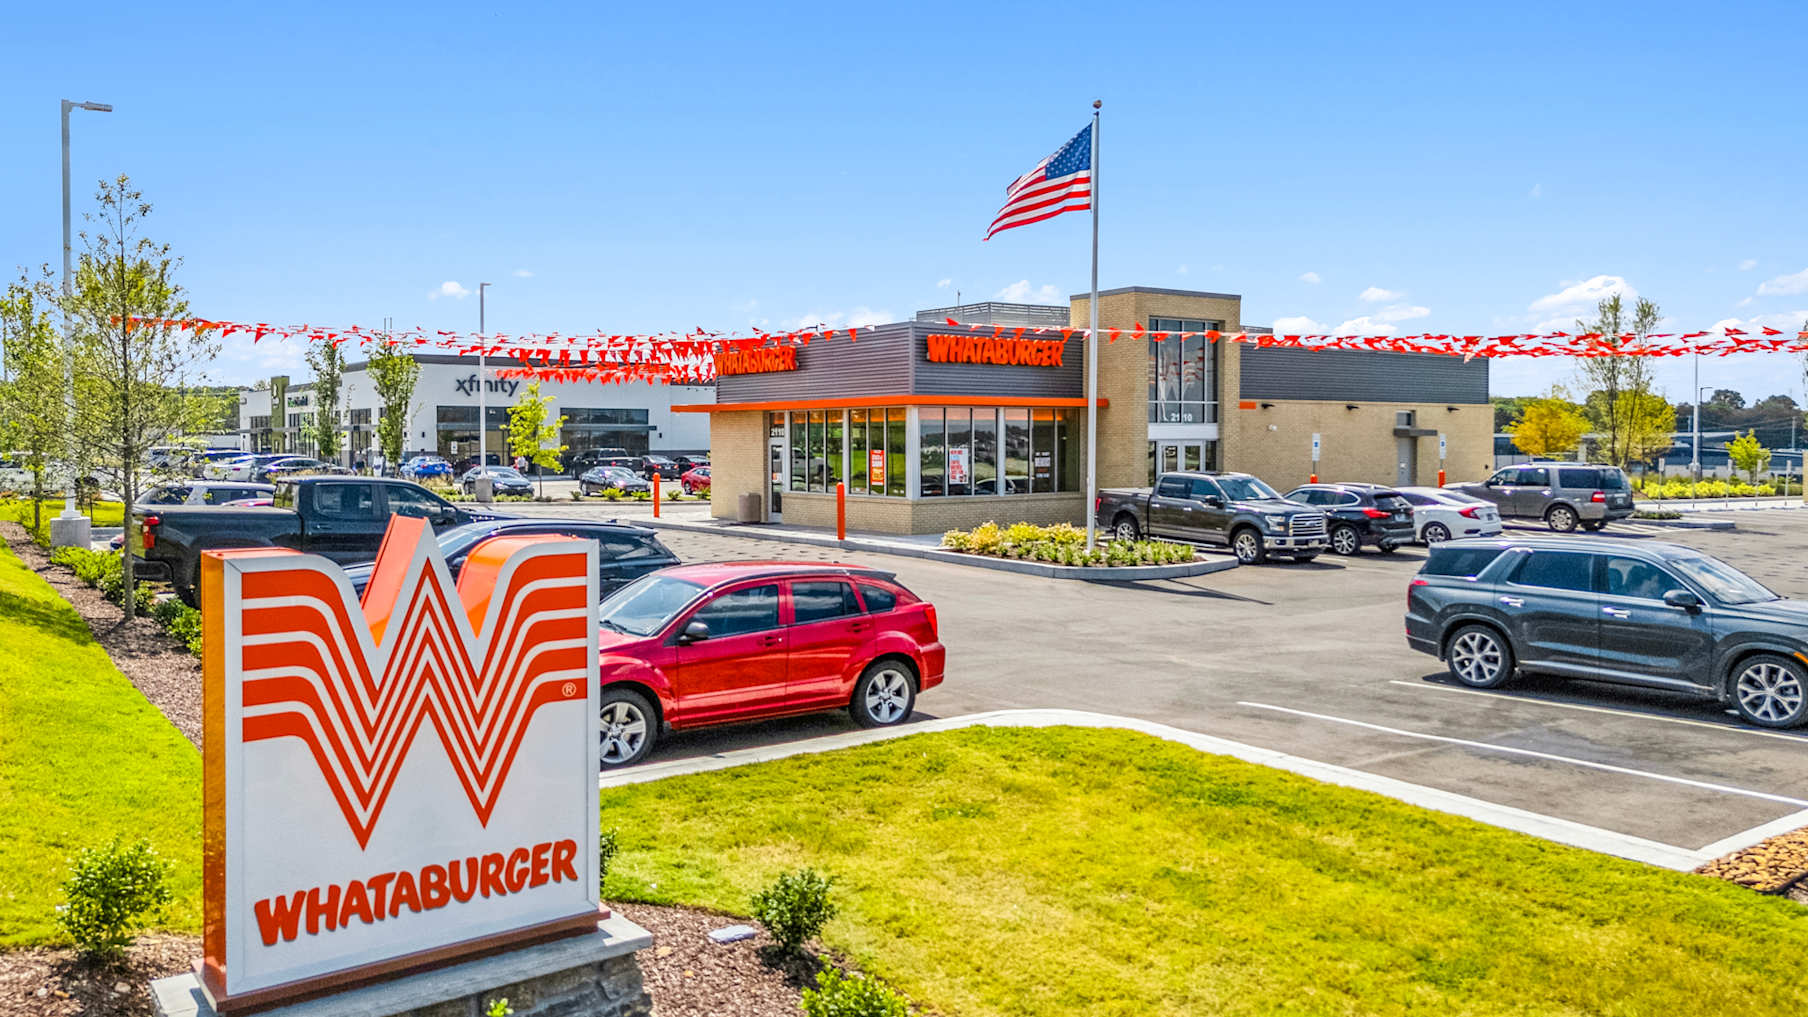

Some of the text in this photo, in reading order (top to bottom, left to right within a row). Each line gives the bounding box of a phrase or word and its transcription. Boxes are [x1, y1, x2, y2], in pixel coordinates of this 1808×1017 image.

[714, 345, 797, 377] WHATABURGER
[927, 333, 1065, 367] WHATABURGER
[455, 374, 519, 397] xfinity
[254, 839, 578, 946] WHATABURGER
